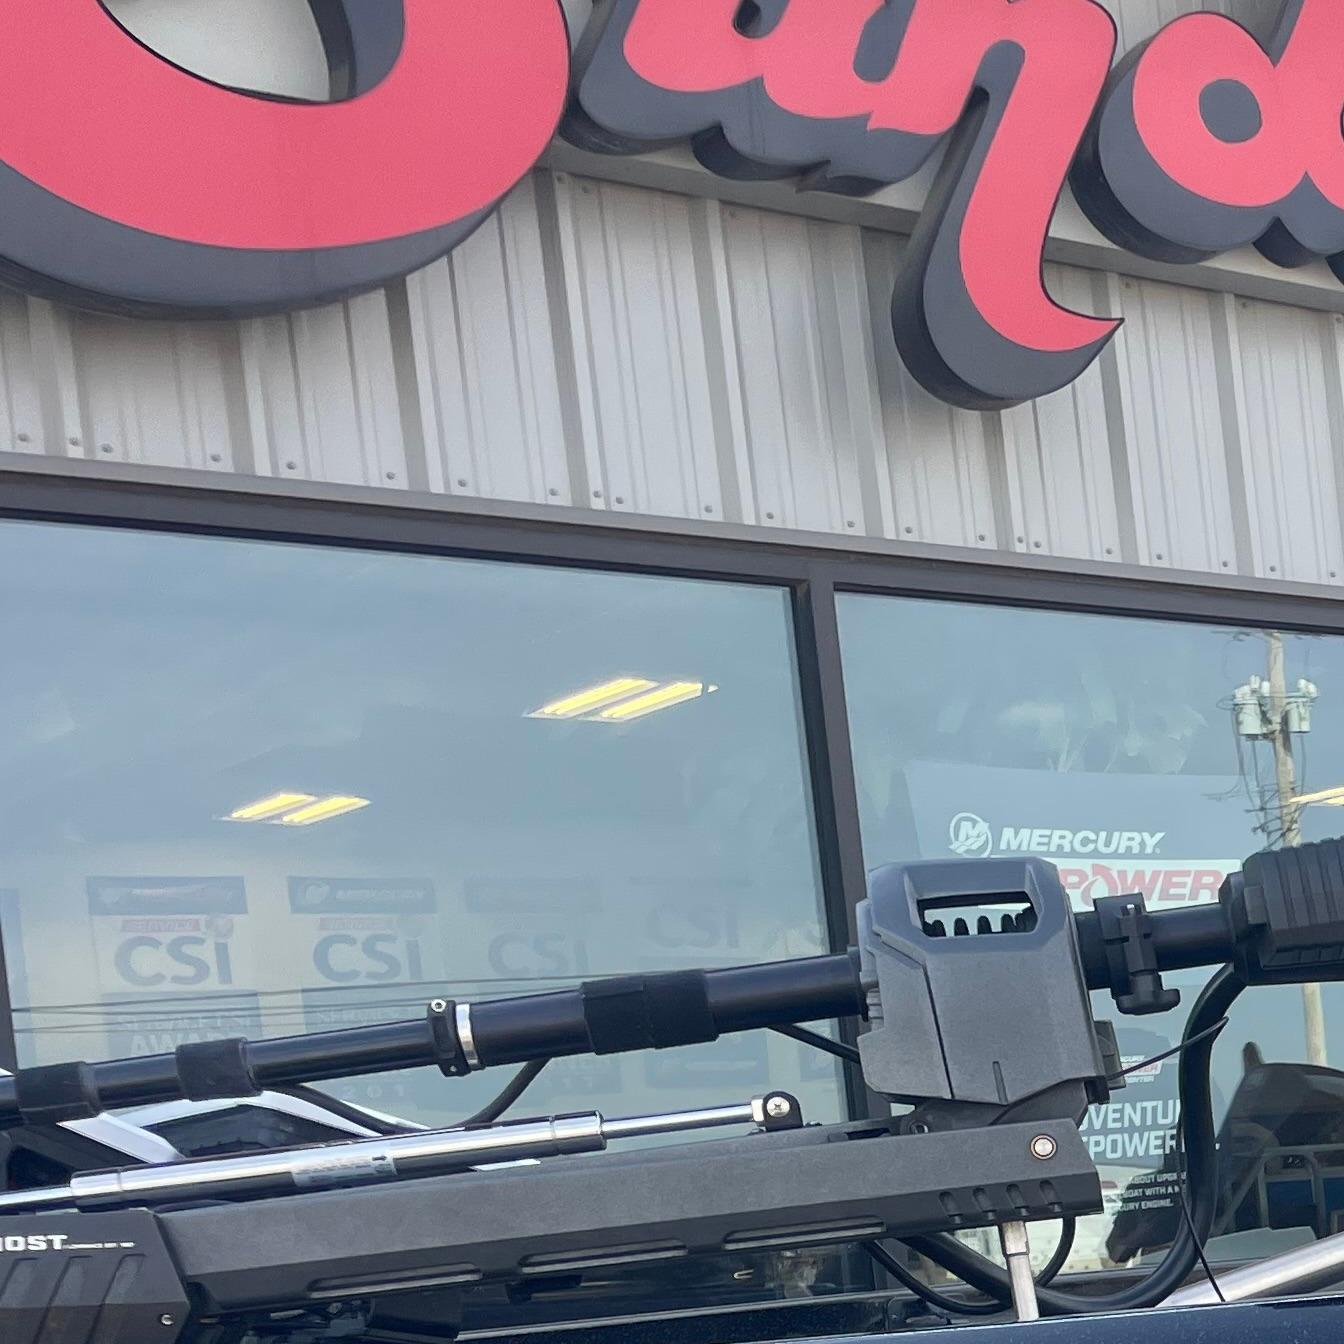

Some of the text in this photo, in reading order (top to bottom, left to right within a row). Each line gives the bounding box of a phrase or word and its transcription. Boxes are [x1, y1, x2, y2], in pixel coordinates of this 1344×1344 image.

[999, 827, 1166, 855] MERCURY
[1079, 1099, 1181, 1131] VENTU
[1083, 1129, 1186, 1161] POWER
[0, 1235, 69, 1252] OST
